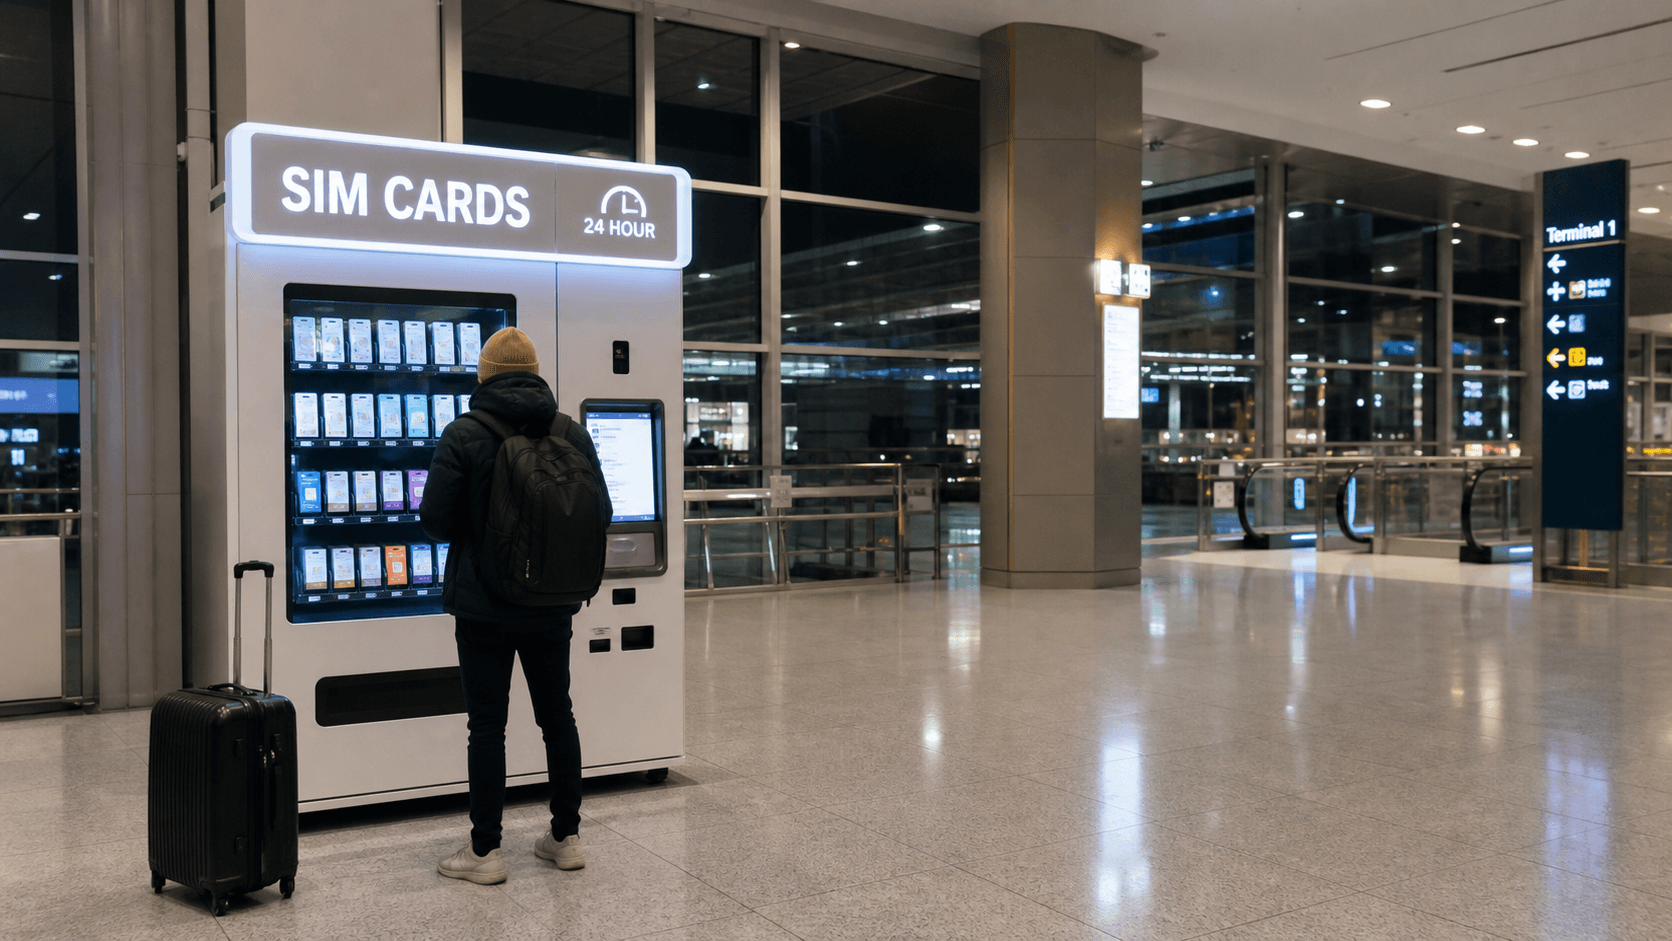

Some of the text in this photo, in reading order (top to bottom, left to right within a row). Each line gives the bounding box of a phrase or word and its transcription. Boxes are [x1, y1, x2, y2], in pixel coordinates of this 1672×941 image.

[281, 166, 531, 228] SIM CARDS
[583, 217, 656, 239] 24 HOUR
[1546, 219, 1616, 243] Terminal 1
